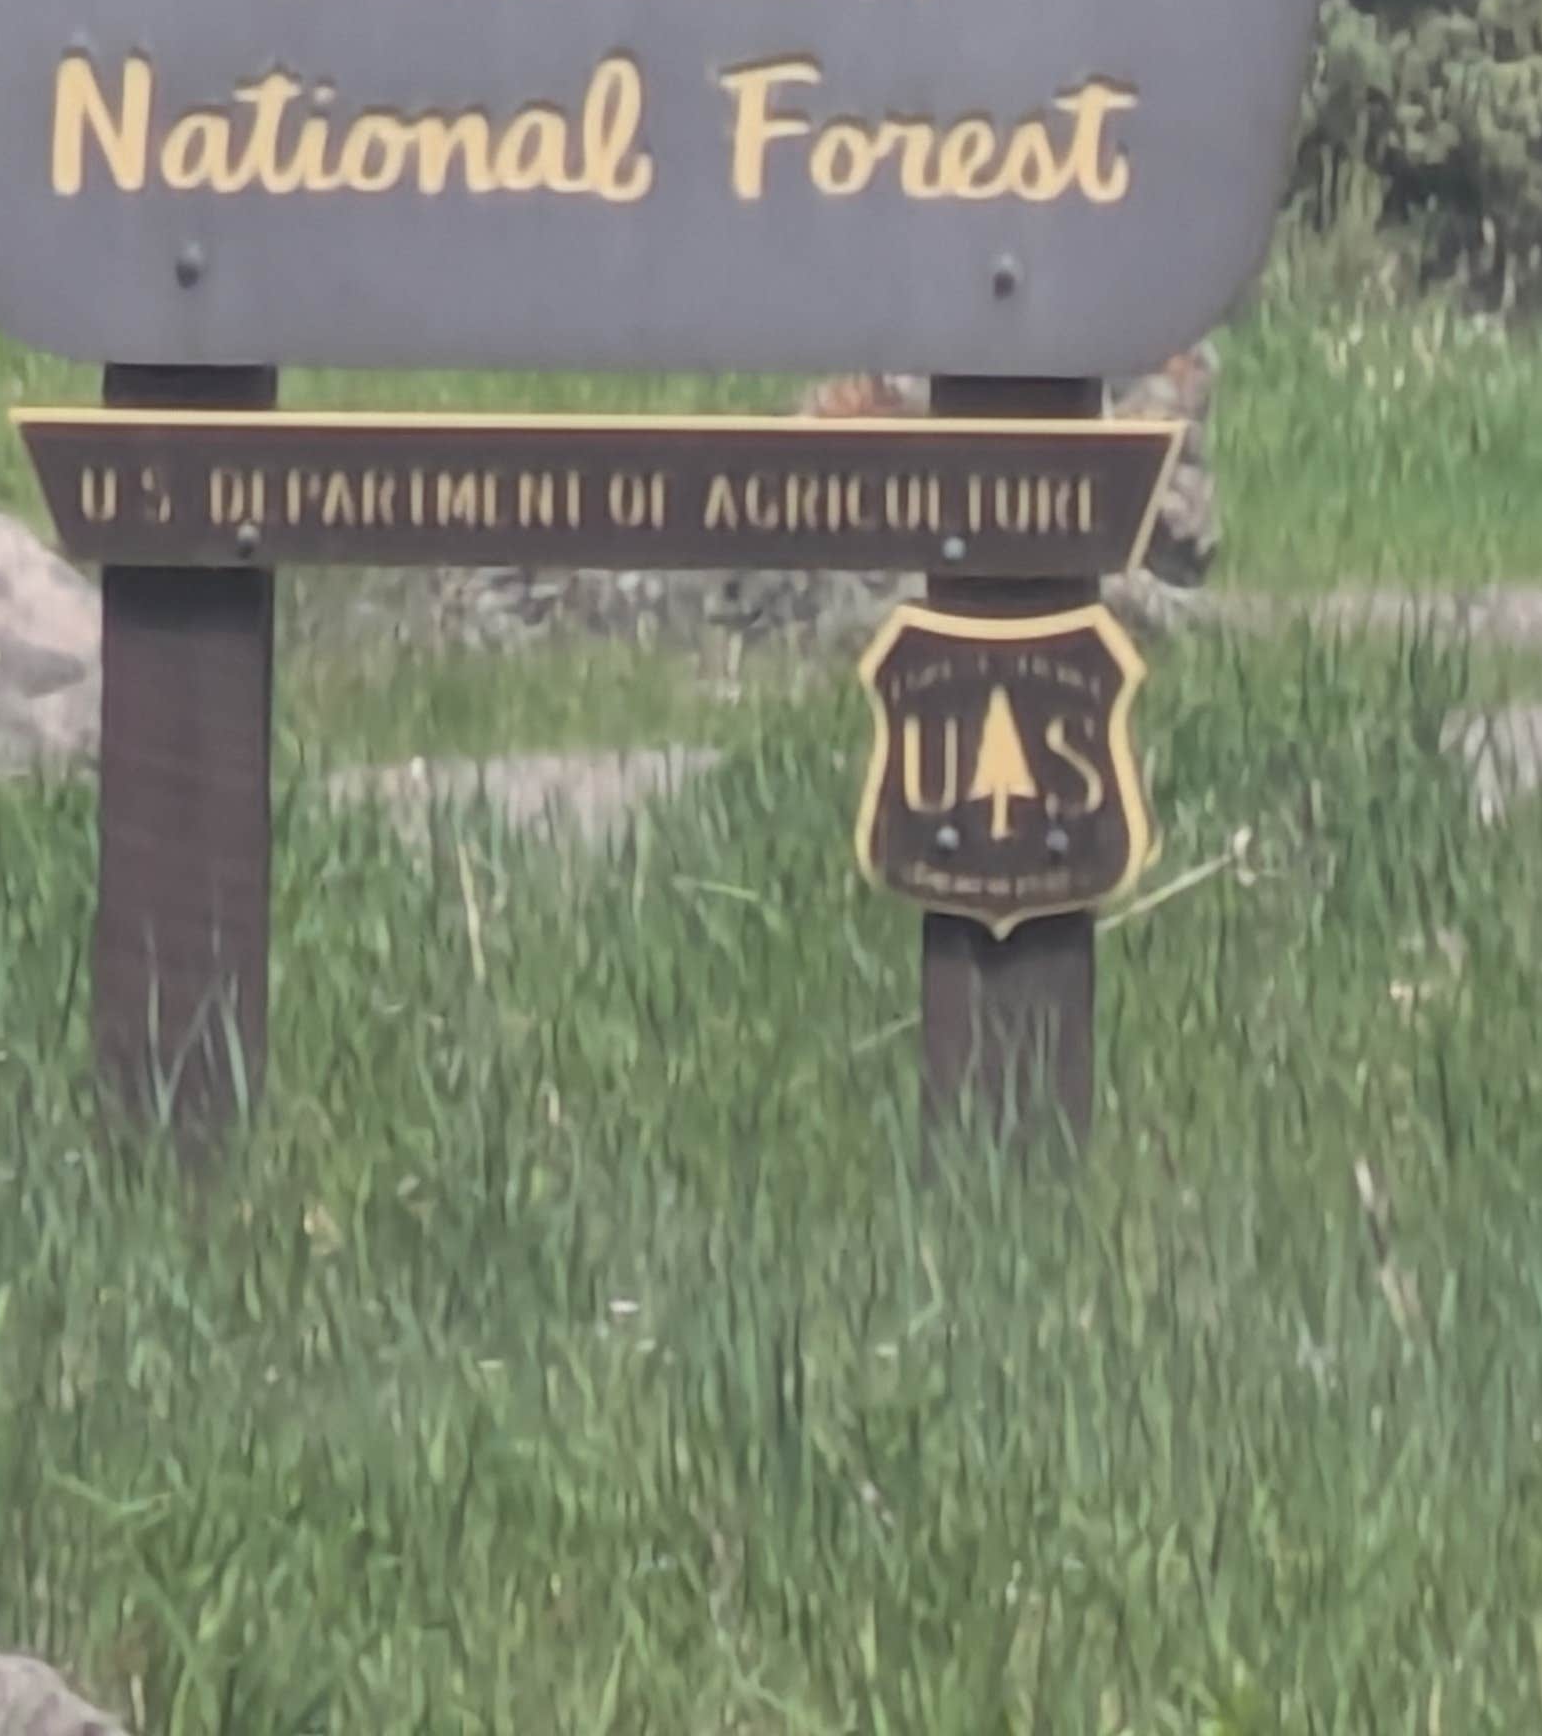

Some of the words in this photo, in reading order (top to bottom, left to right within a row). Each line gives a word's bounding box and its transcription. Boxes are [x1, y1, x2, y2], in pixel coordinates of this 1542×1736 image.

[52, 57, 652, 202] National
[717, 64, 1135, 203] Forest
[209, 468, 587, 528] DEPARTMENT
[608, 472, 671, 528] OF
[704, 474, 1099, 532] AGRICULTURE
